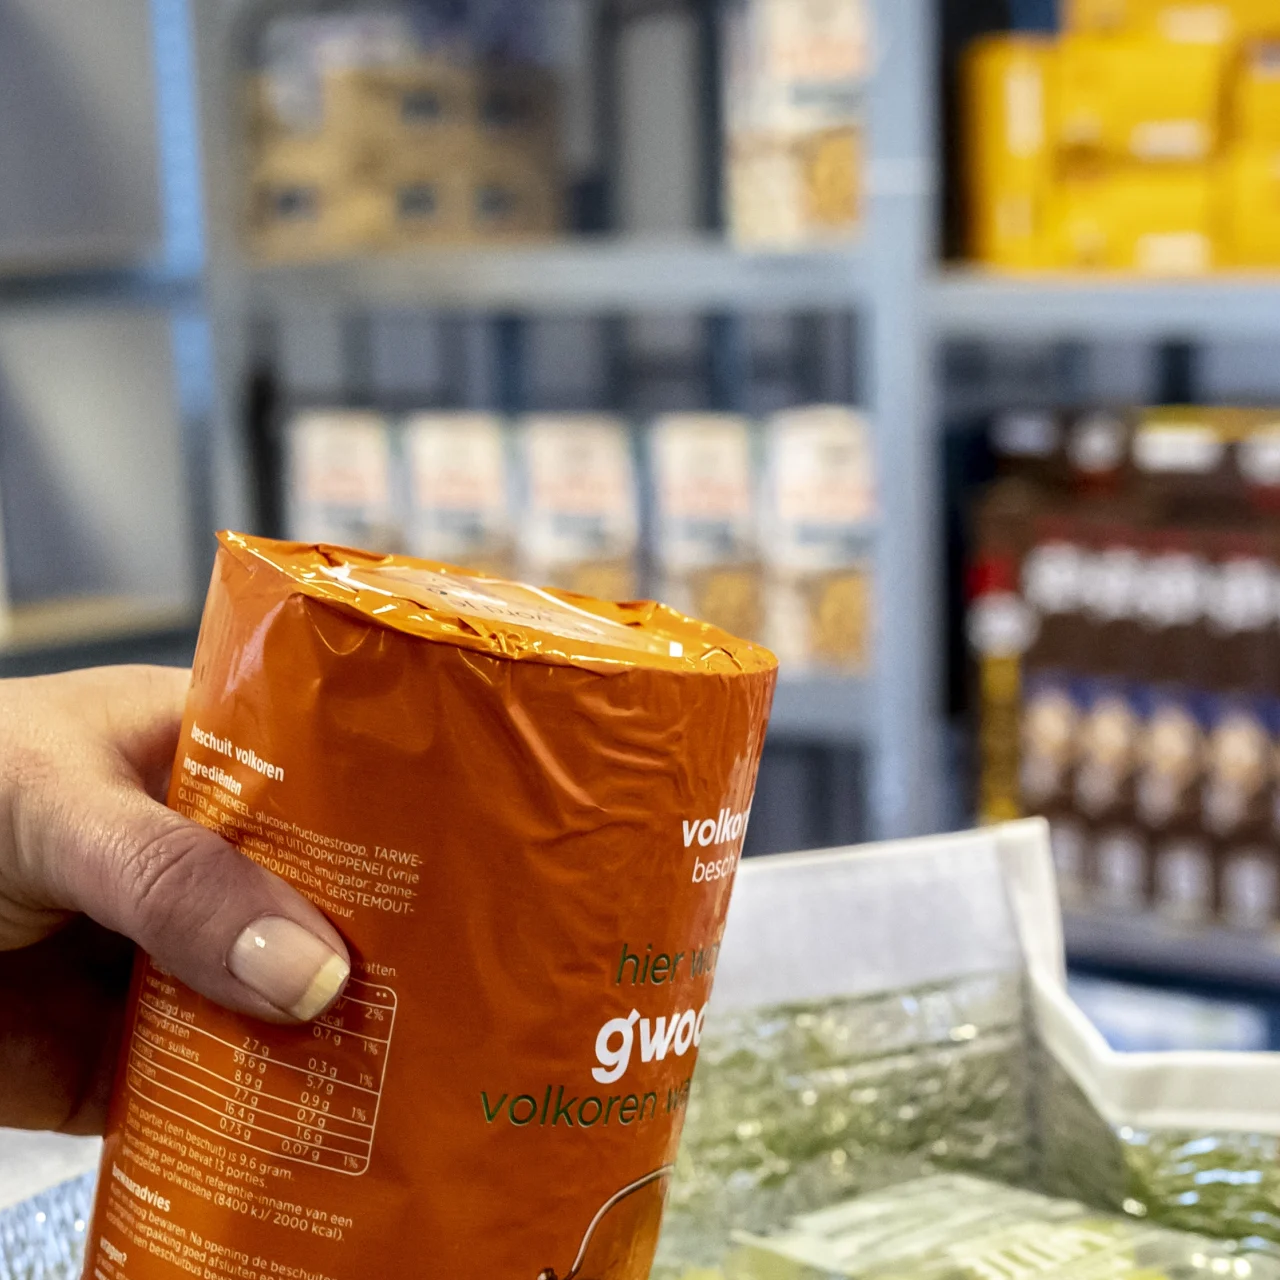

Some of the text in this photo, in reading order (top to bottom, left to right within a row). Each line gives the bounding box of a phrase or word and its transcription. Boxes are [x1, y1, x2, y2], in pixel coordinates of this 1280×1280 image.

[235, 746, 285, 782] volkoren
[285, 835, 384, 876] UITLOOPKIPPENEI
[386, 866, 420, 884] (vrije
[373, 846, 423, 867] TARWE-
[325, 883, 415, 915] GERSTEMOUT-
[374, 881, 418, 899] zonne-
[615, 943, 683, 986] hier
[364, 1006, 385, 1022] 2%
[333, 1034, 342, 1046] g
[258, 1062, 267, 1075] g
[326, 1083, 335, 1096] g
[261, 1046, 270, 1059] g
[329, 1066, 338, 1080] g
[250, 1095, 259, 1108] g
[317, 1117, 326, 1130] g
[254, 1078, 263, 1091] g
[322, 1100, 330, 1113] g
[479, 1084, 657, 1128] volkoren
[164, 1120, 184, 1137] (een
[185, 1129, 227, 1159] beschuit)
[228, 1151, 237, 1163] is
[243, 1129, 252, 1142] g
[311, 1150, 320, 1162] g
[247, 1112, 256, 1125] g
[314, 1133, 323, 1146] g
[188, 1147, 213, 1169] bevat
[214, 1159, 225, 1173] 13
[225, 1165, 268, 1189] porties.
[160, 1153, 175, 1167] per
[205, 1174, 303, 1215] referentie-inname
[305, 1207, 328, 1221] van
[330, 1214, 353, 1229] een
[213, 1192, 249, 1214] (8400
[273, 1212, 309, 1232] 2000
[148, 1239, 202, 1278] beschuitbus
[182, 1243, 207, 1264] goed
[207, 1255, 257, 1280] afsluiten
[189, 1230, 203, 1247] Na
[204, 1239, 250, 1265] opening
[252, 1255, 268, 1270] de
